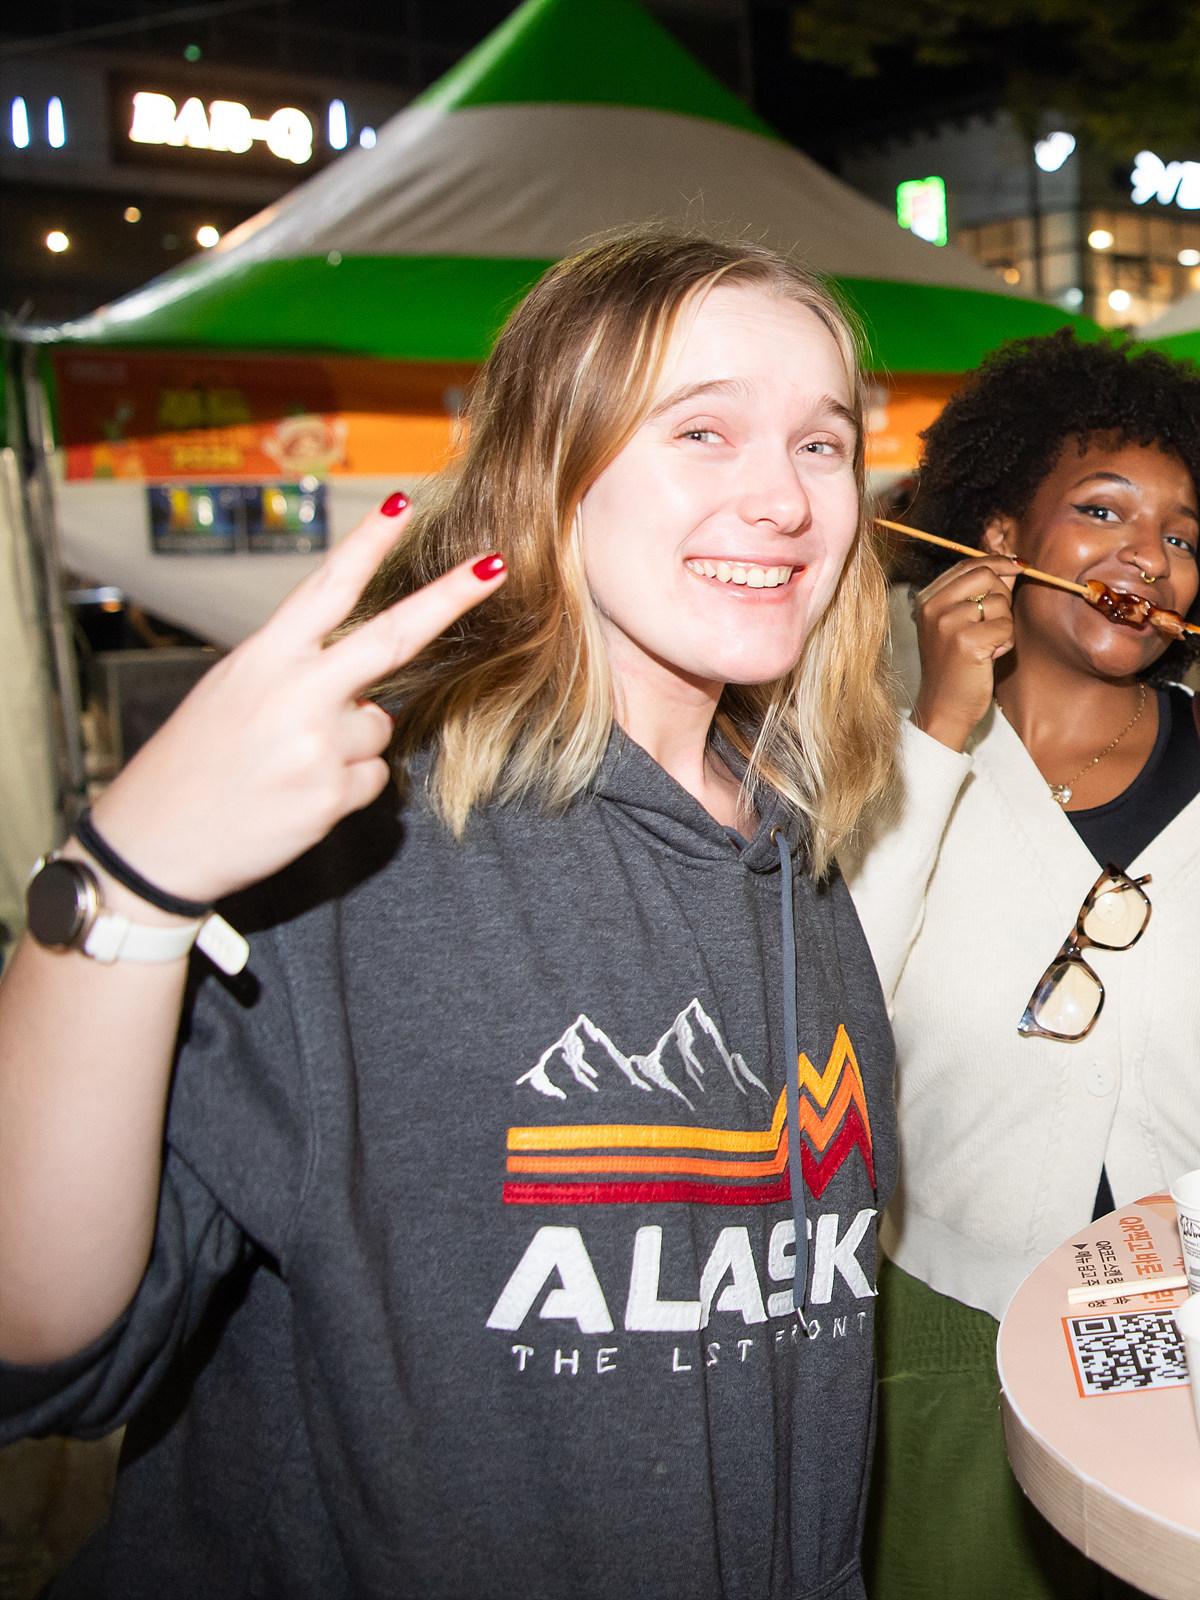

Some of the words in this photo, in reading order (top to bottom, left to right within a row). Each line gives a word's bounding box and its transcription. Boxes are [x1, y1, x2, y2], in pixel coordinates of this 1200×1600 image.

[1119, 1216, 1154, 1252] QR찍고
[1075, 1250, 1092, 1265] 메뉴
[1096, 1240, 1117, 1263] QR코드
[1078, 1264, 1097, 1279] 담고
[1131, 1252, 1163, 1276] 바로
[511, 1344, 618, 1376] THE
[672, 1338, 754, 1373] LST
